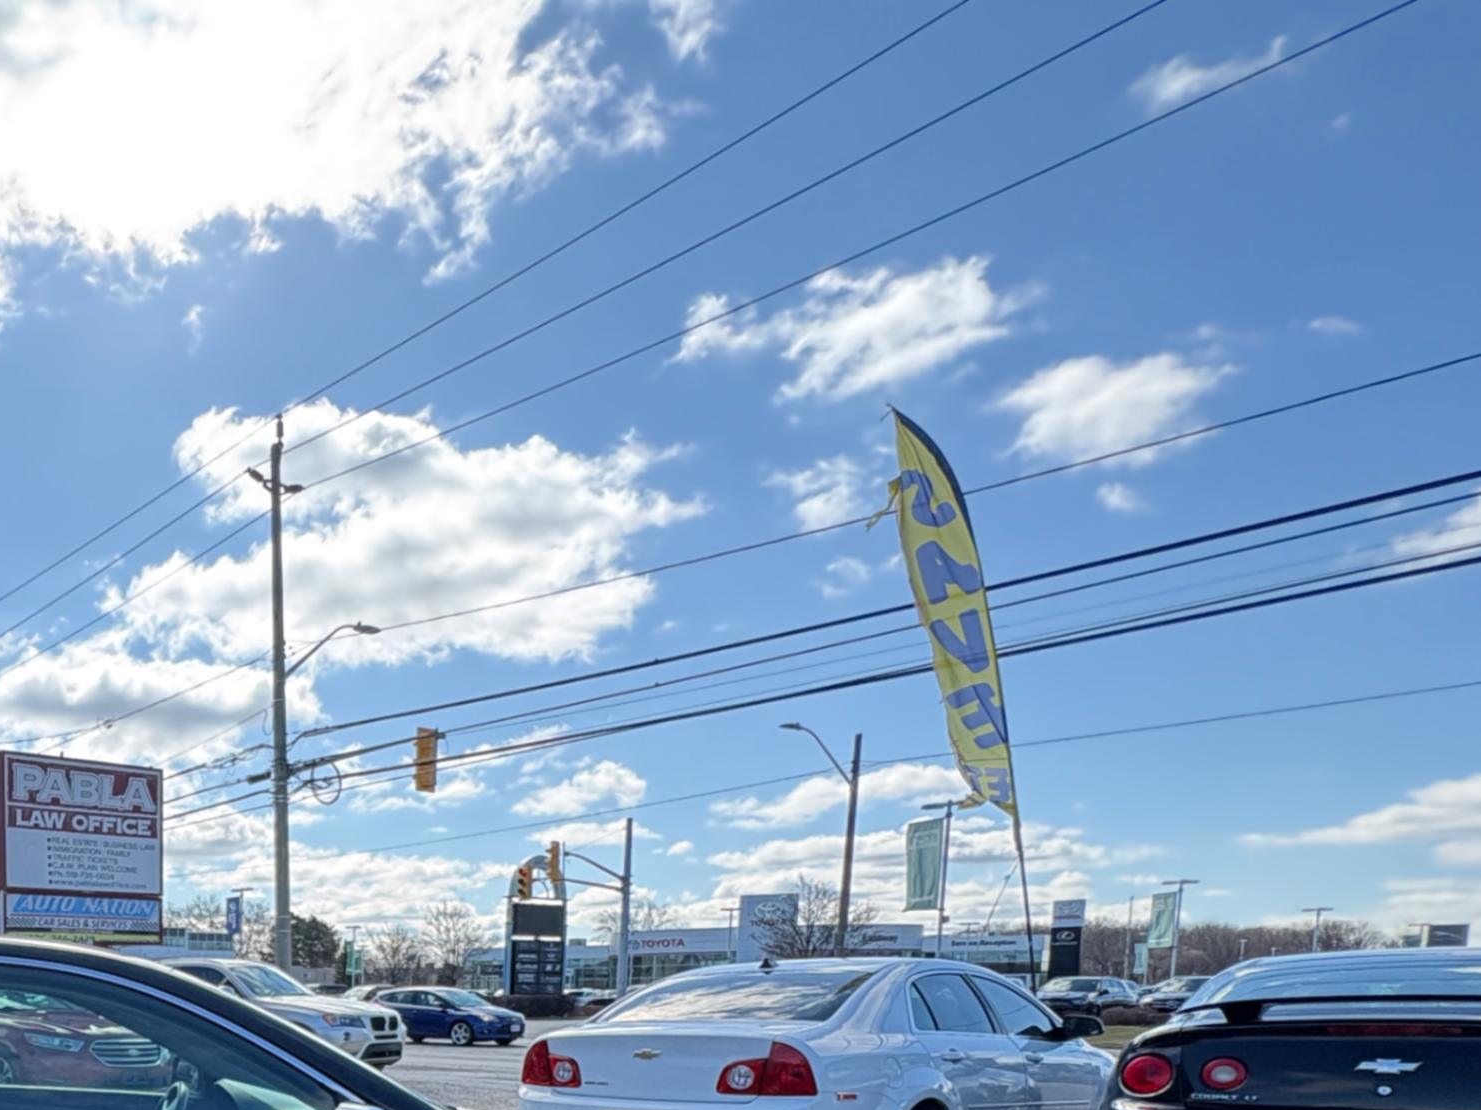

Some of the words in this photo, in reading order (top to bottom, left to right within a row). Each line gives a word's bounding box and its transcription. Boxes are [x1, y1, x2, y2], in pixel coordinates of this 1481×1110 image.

[11, 762, 157, 813] PABLA
[15, 808, 66, 830] LAW
[71, 815, 152, 836] OFFICE
[52, 837, 70, 846] REAL
[73, 838, 98, 848] ESTATE
[53, 854, 84, 863] TRAFFIC
[87, 856, 118, 865] TICKETS
[77, 863, 98, 871] PLAN
[100, 865, 138, 874] WELCOME
[19, 895, 76, 912] AUTO
[81, 897, 153, 915] NATION
[38, 917, 55, 926] CAR
[57, 918, 81, 928] SALES
[91, 919, 129, 929] SERVICES
[640, 938, 685, 948] TOYOTA
